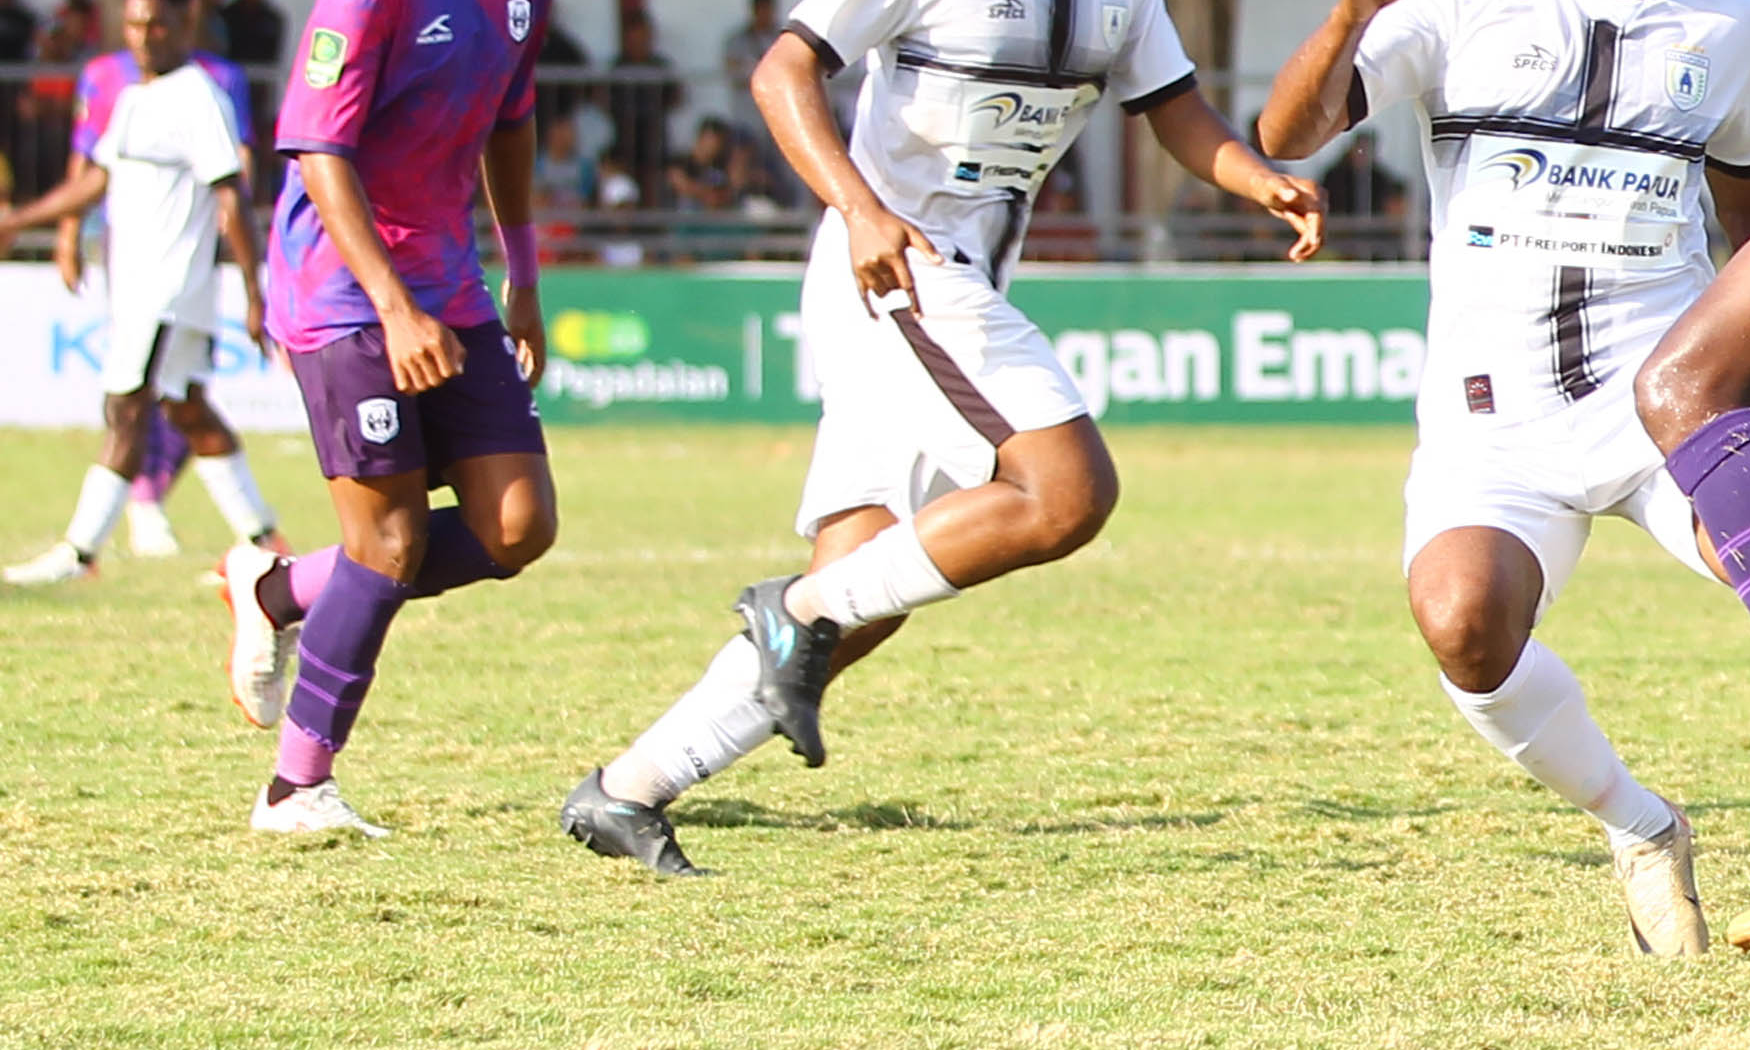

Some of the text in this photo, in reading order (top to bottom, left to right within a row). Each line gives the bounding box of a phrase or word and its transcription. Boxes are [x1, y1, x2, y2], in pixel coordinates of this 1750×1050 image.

[1513, 57, 1557, 71] SPECS
[1547, 164, 1616, 190] BANK
[1500, 233, 1520, 248] PT
[545, 356, 730, 409] Pegadaian
